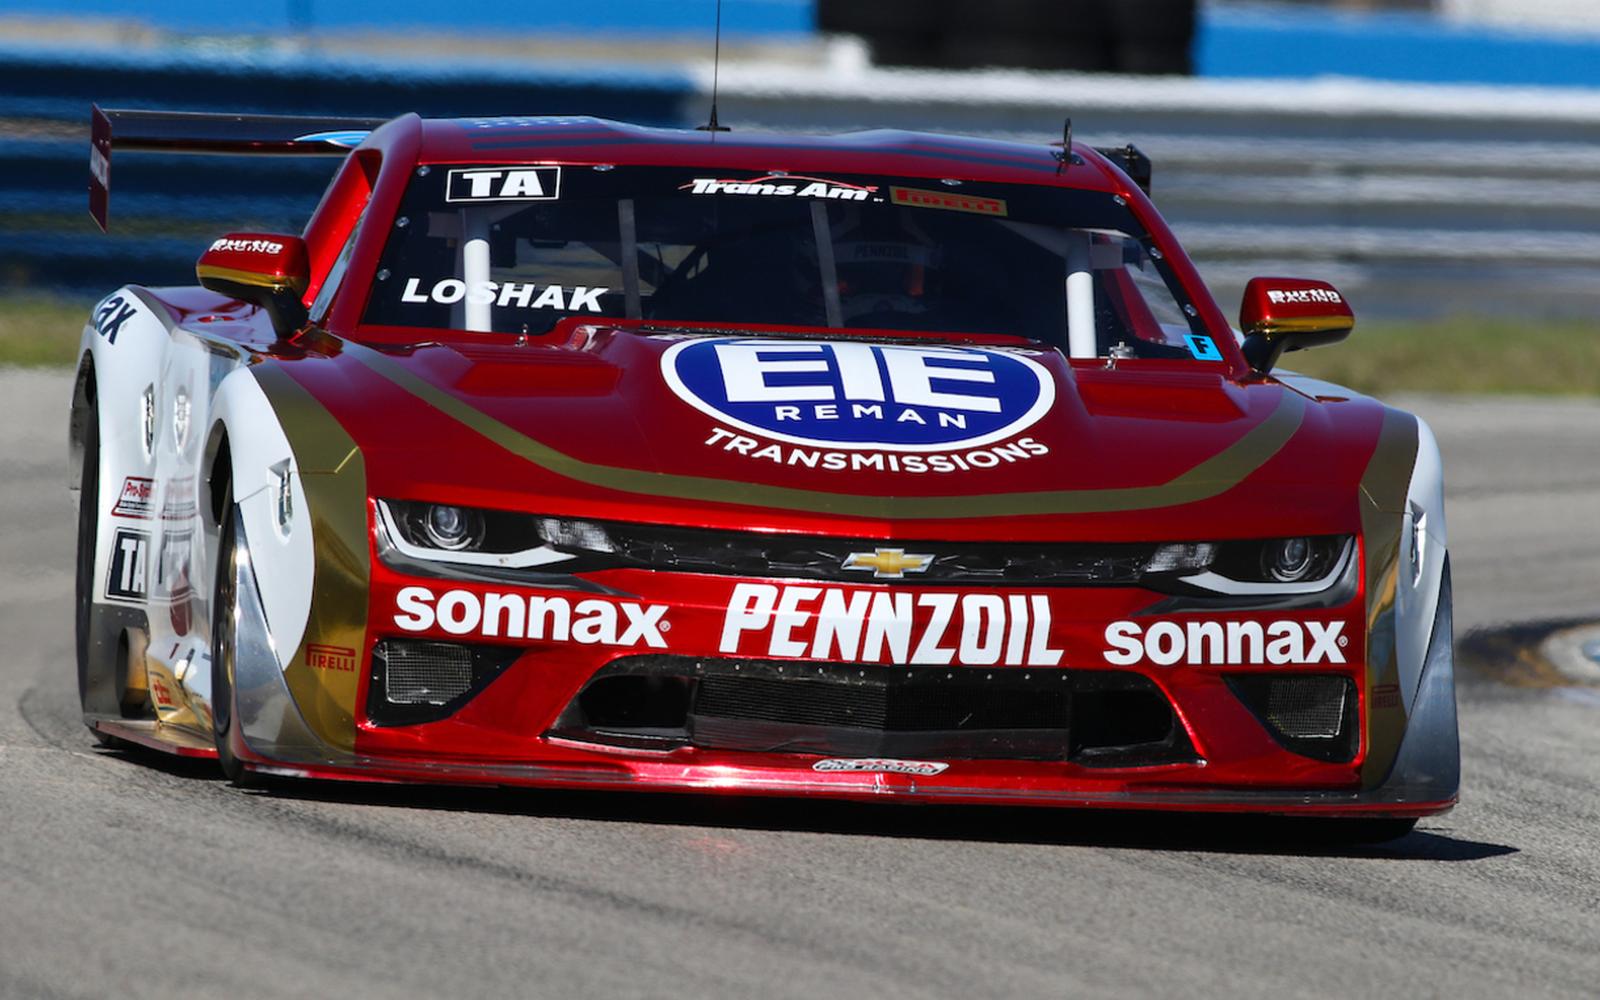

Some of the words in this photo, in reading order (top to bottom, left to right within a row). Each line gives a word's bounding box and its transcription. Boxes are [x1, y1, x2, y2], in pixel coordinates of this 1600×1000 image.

[463, 171, 544, 197] TA
[692, 178, 797, 196] Trans
[797, 182, 868, 200] Am
[895, 188, 1001, 213] PIRELLI
[401, 277, 609, 312] LOSHAK
[1191, 337, 1210, 354] F
[714, 343, 1003, 414] EIE
[775, 404, 968, 430] REMAN
[705, 427, 1050, 473] TRANSMISSIONS
[719, 582, 1065, 667] PENNZOIL
[306, 643, 356, 673] PIRELLI
